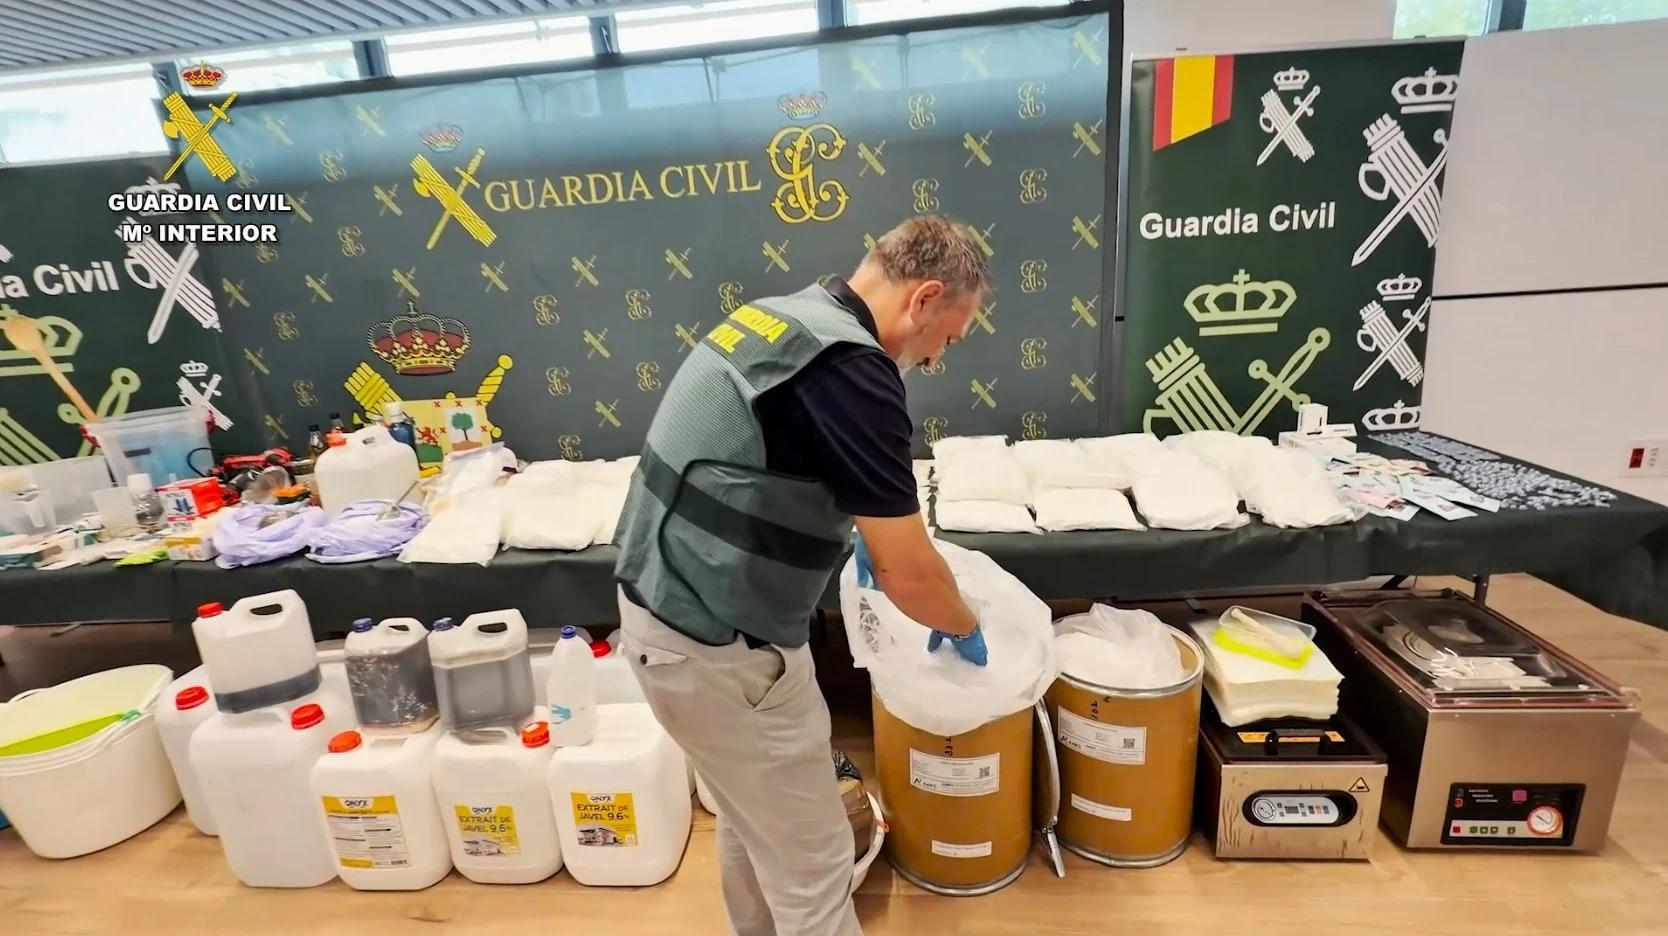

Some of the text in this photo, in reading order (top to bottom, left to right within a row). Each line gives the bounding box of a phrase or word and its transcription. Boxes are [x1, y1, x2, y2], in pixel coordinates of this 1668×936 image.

[483, 160, 762, 213] GUARDIA CIVIL
[1139, 201, 1336, 240] Guardia Civil
[33, 260, 120, 296] Civil
